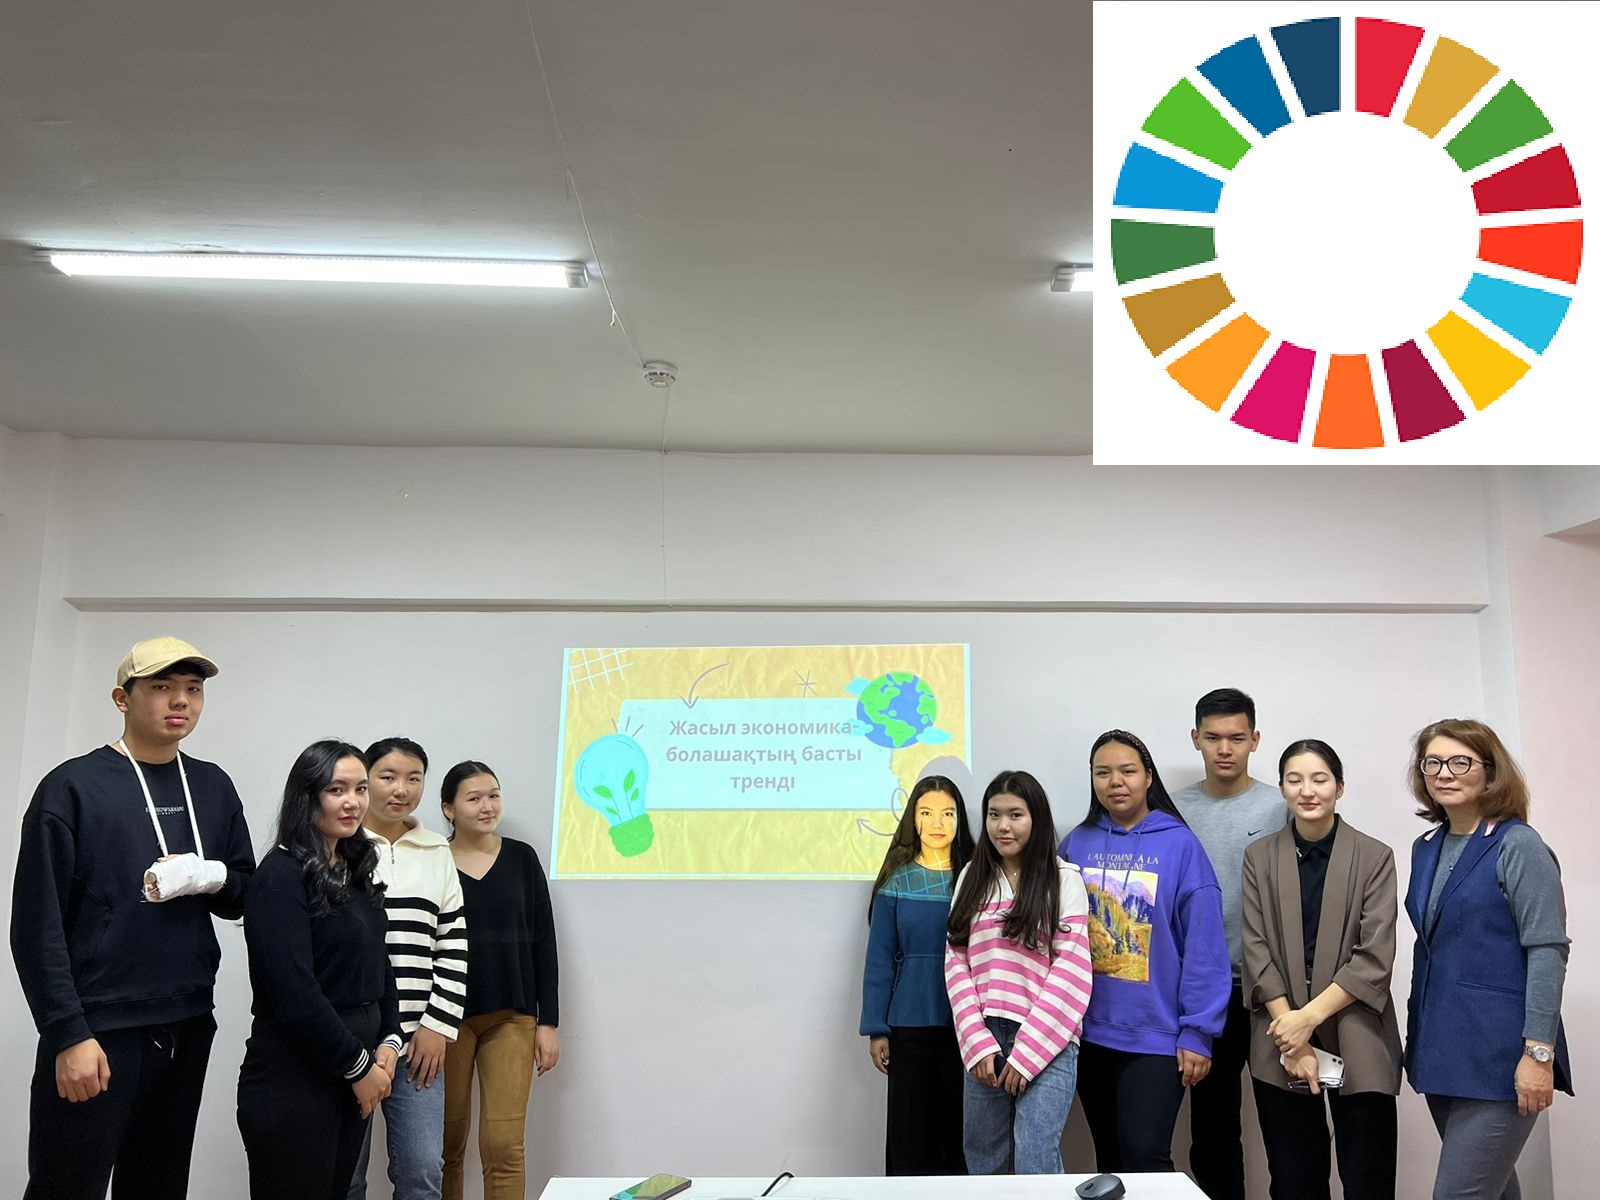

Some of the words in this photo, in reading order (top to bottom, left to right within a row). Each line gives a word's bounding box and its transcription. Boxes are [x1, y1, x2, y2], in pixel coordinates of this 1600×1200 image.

[669, 720, 736, 735] Жасыл
[666, 747, 797, 764] болашақтың
[802, 746, 861, 761] басты
